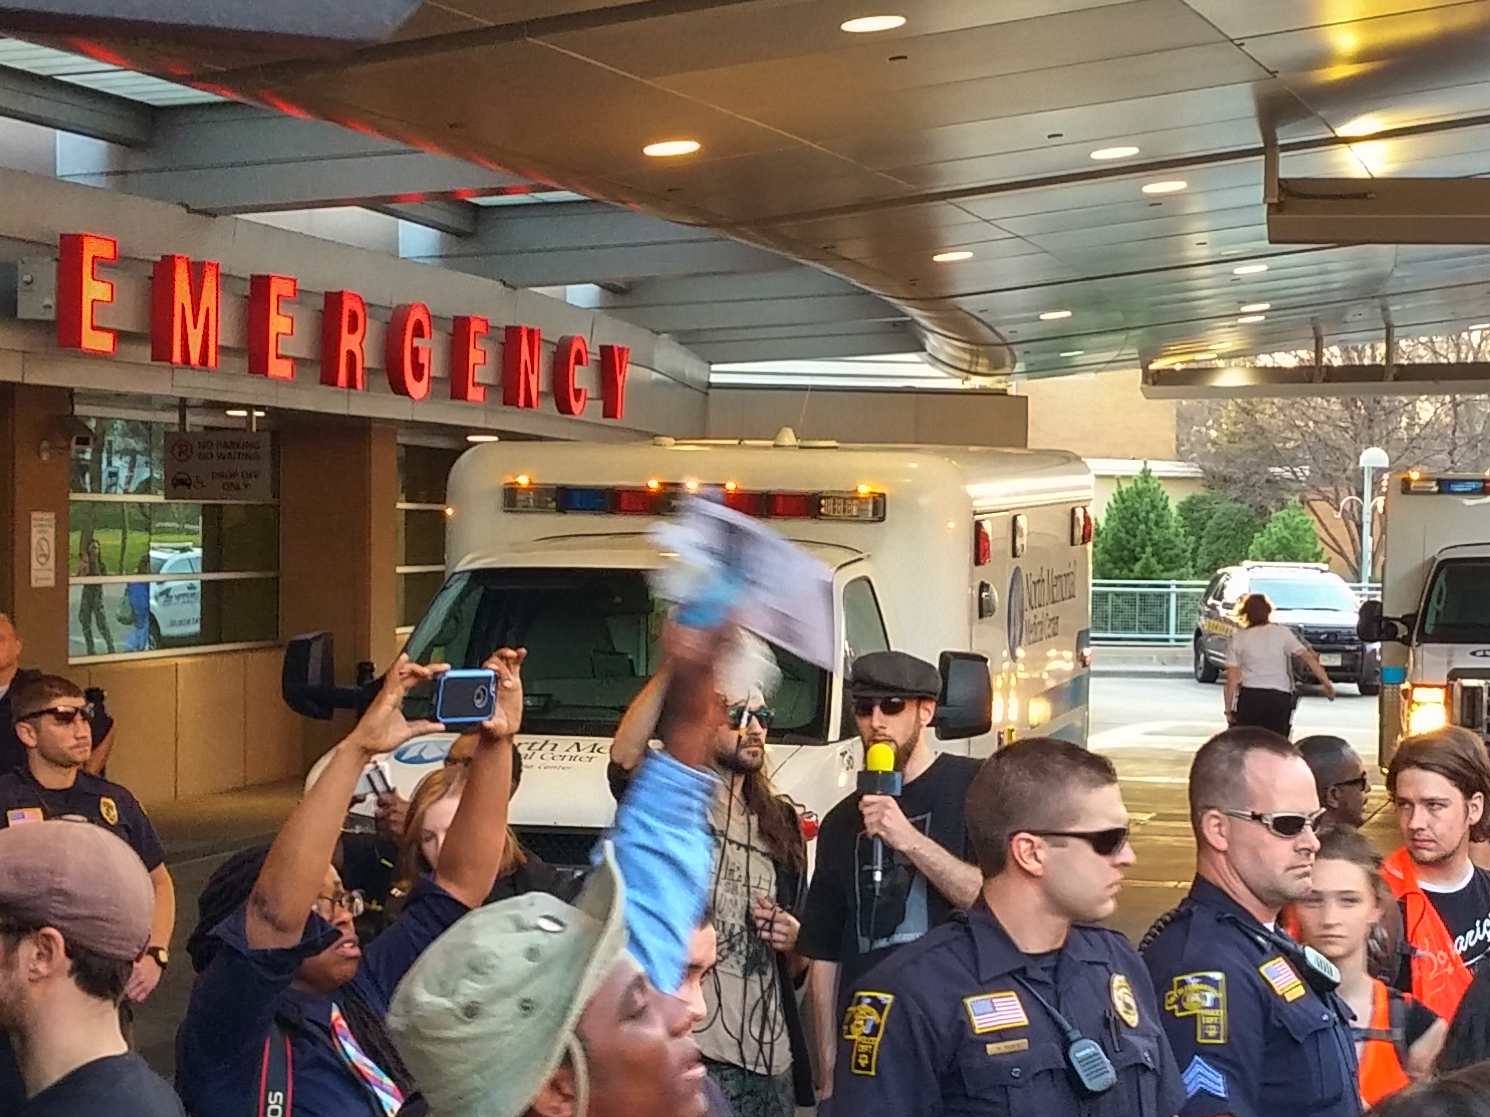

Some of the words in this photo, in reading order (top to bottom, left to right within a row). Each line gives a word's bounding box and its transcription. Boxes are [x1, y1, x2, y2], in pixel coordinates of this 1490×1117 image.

[58, 233, 630, 419] EMERGENCY
[197, 441, 213, 450] NO
[216, 441, 260, 450] PARKING
[197, 452, 213, 460] NO
[216, 452, 260, 461] WAITING
[222, 482, 250, 491] ONLY
[516, 740, 559, 753] rth
[540, 752, 597, 763] Center
